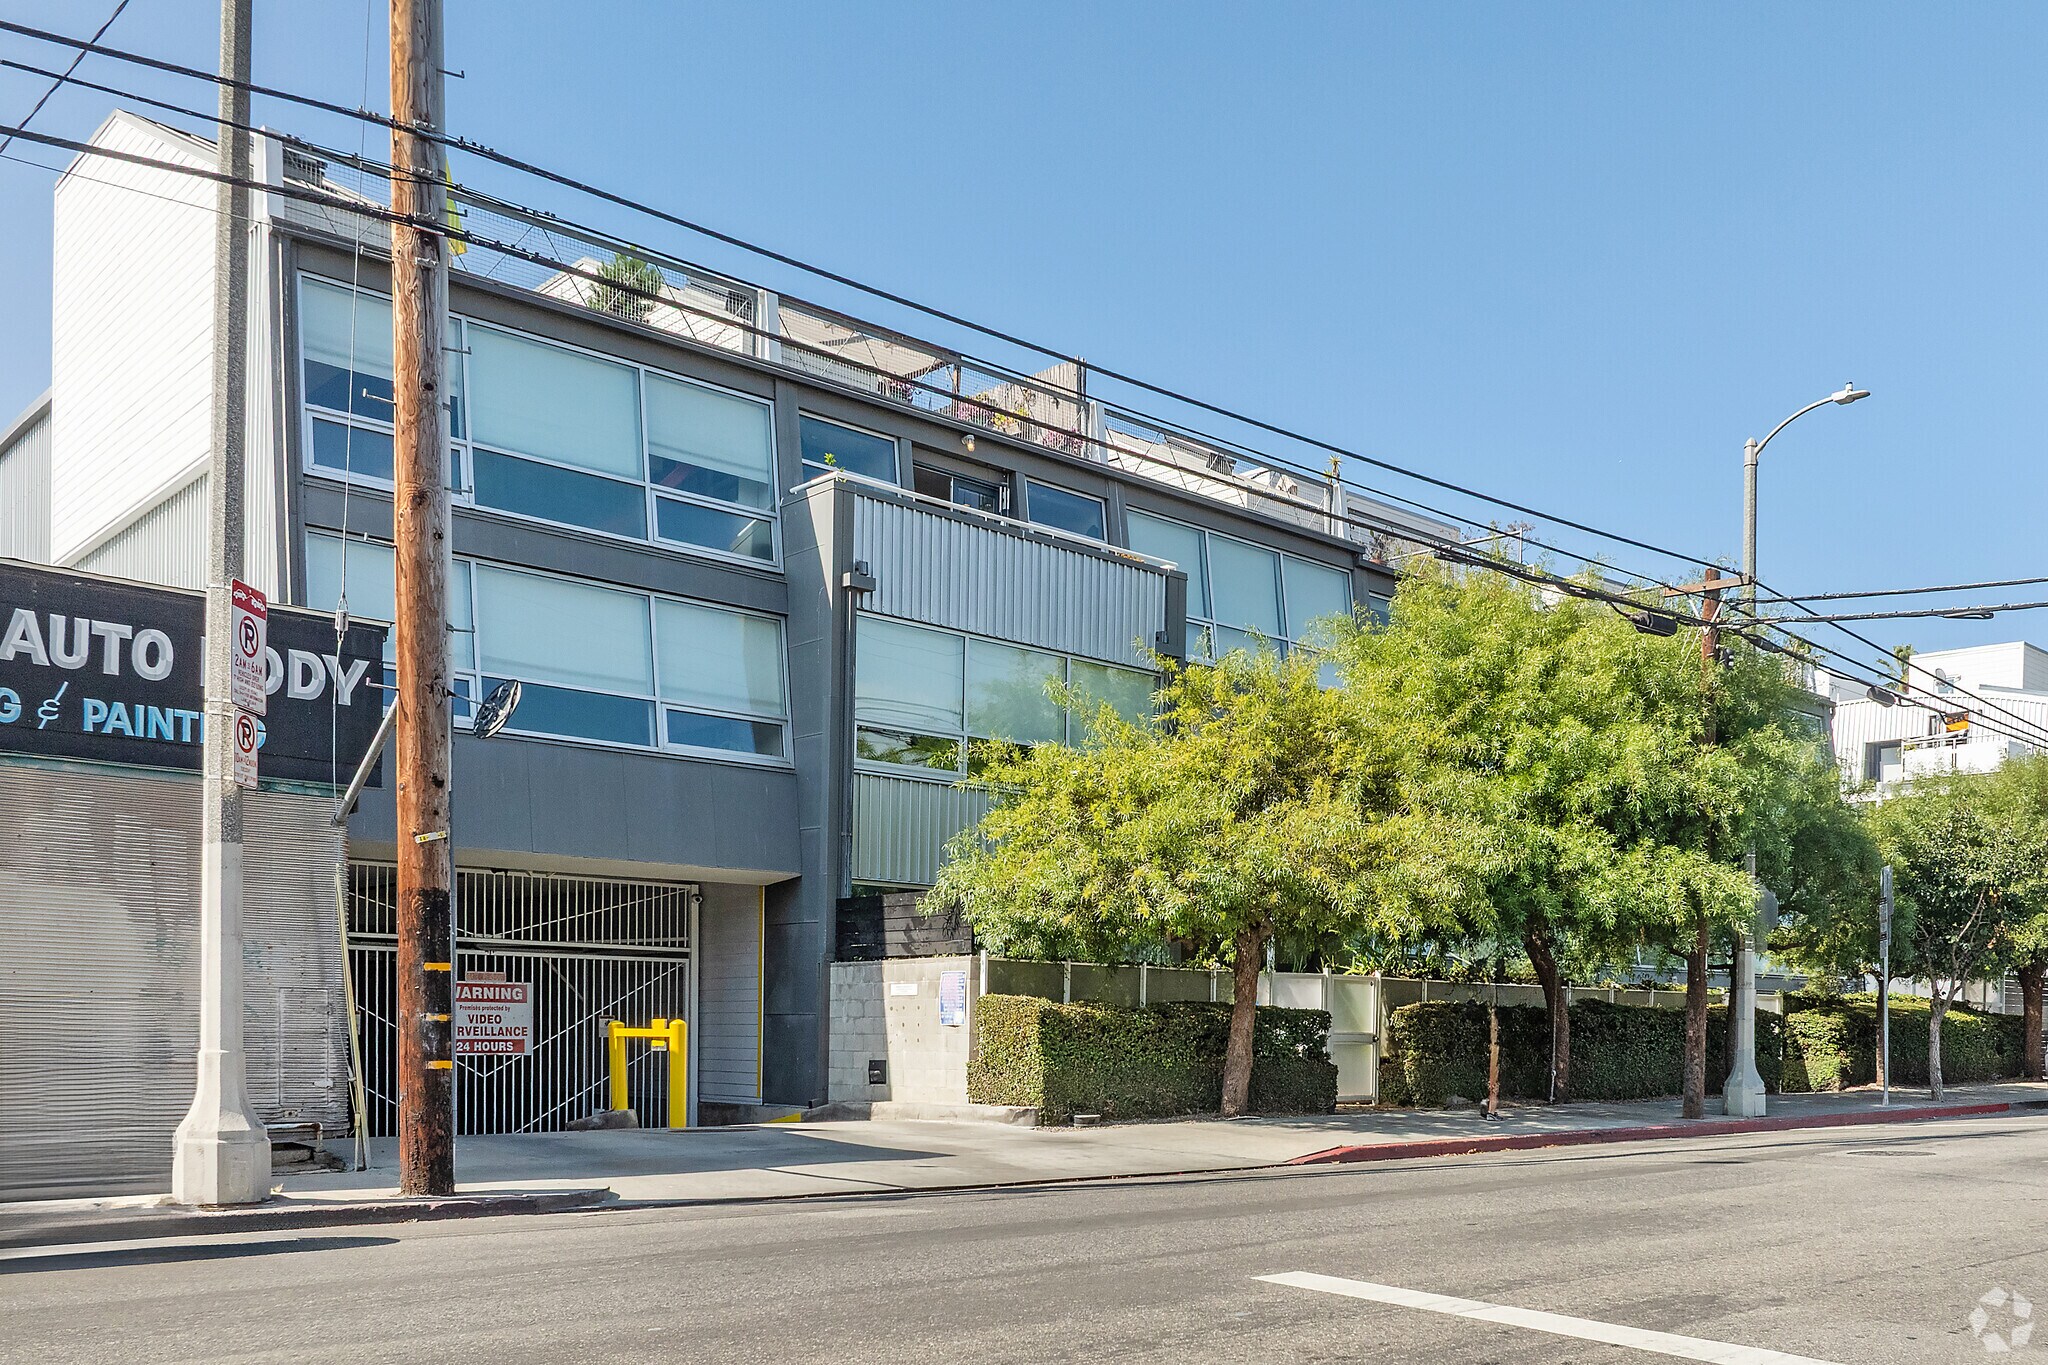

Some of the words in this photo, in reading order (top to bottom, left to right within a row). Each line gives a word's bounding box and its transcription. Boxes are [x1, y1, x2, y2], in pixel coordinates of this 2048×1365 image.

[0, 608, 174, 681] AUTO
[200, 636, 370, 706] DY
[235, 653, 246, 670] 2AM
[251, 662, 263, 676] 6AM
[83, 697, 267, 750] PAINT
[504, 1005, 511, 1013] by
[468, 1014, 502, 1024] VIDEO
[457, 1026, 528, 1037] RVEILLANCE
[456, 1041, 470, 1051] 24
[474, 1041, 514, 1052] HOURS
